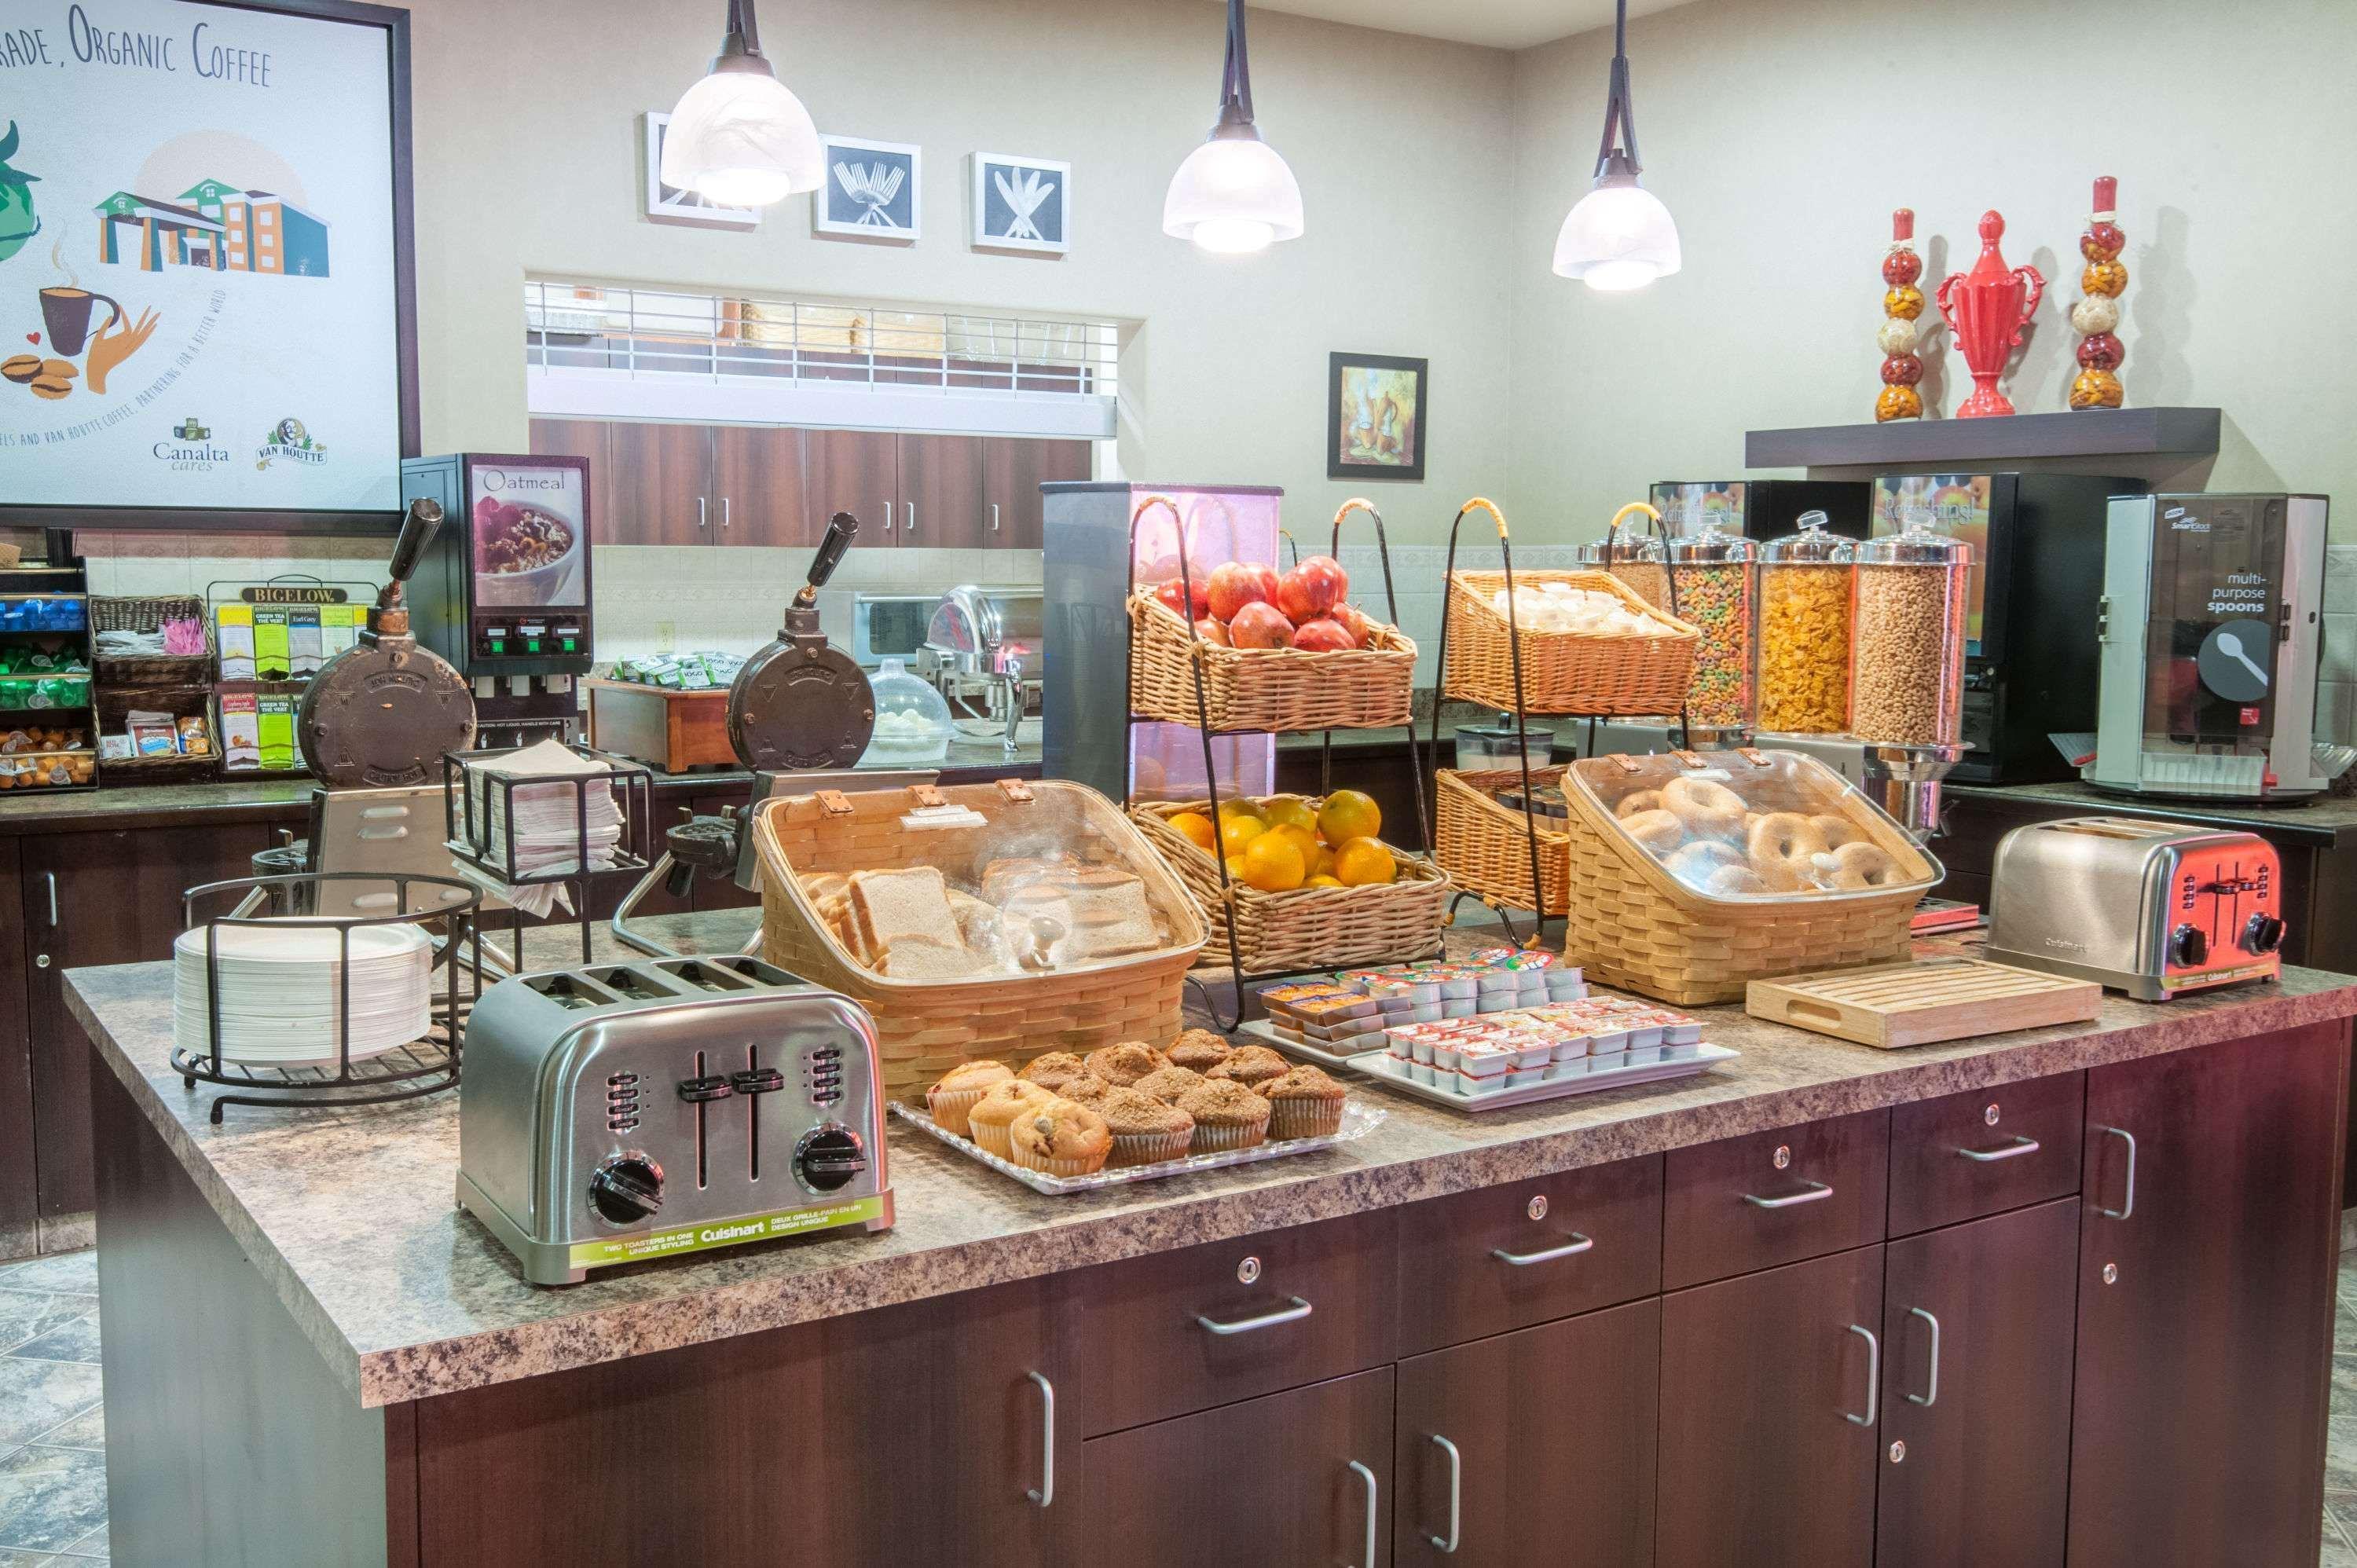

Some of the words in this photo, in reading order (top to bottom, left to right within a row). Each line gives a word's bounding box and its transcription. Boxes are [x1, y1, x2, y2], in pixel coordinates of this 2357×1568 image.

[192, 22, 271, 87] COFFEE
[192, 316, 217, 345] BETTER
[188, 345, 200, 354] A
[177, 352, 194, 368] FOR
[135, 368, 181, 407] PARTNERING
[20, 432, 39, 446] AND
[45, 430, 64, 444] VAN
[153, 442, 229, 462] Canalta
[258, 446, 278, 458] VAN
[283, 446, 324, 462] HOUTTE
[171, 460, 213, 471] cares
[483, 469, 565, 492] Oatmeal
[2227, 572, 2267, 584] multi-
[2212, 588, 2266, 600] purpose
[2207, 602, 2265, 614] spoons
[771, 1216, 792, 1225] DEUX
[850, 1203, 862, 1212] UN
[700, 1221, 765, 1243] Cuisinart
[771, 1222, 800, 1232] DESIGN
[801, 1216, 830, 1226] UNIQUE
[623, 1236, 665, 1249] TOASTERS
[676, 1232, 695, 1240] ONE
[629, 1244, 660, 1255] UNIQUE
[660, 1239, 695, 1250] STYLING
